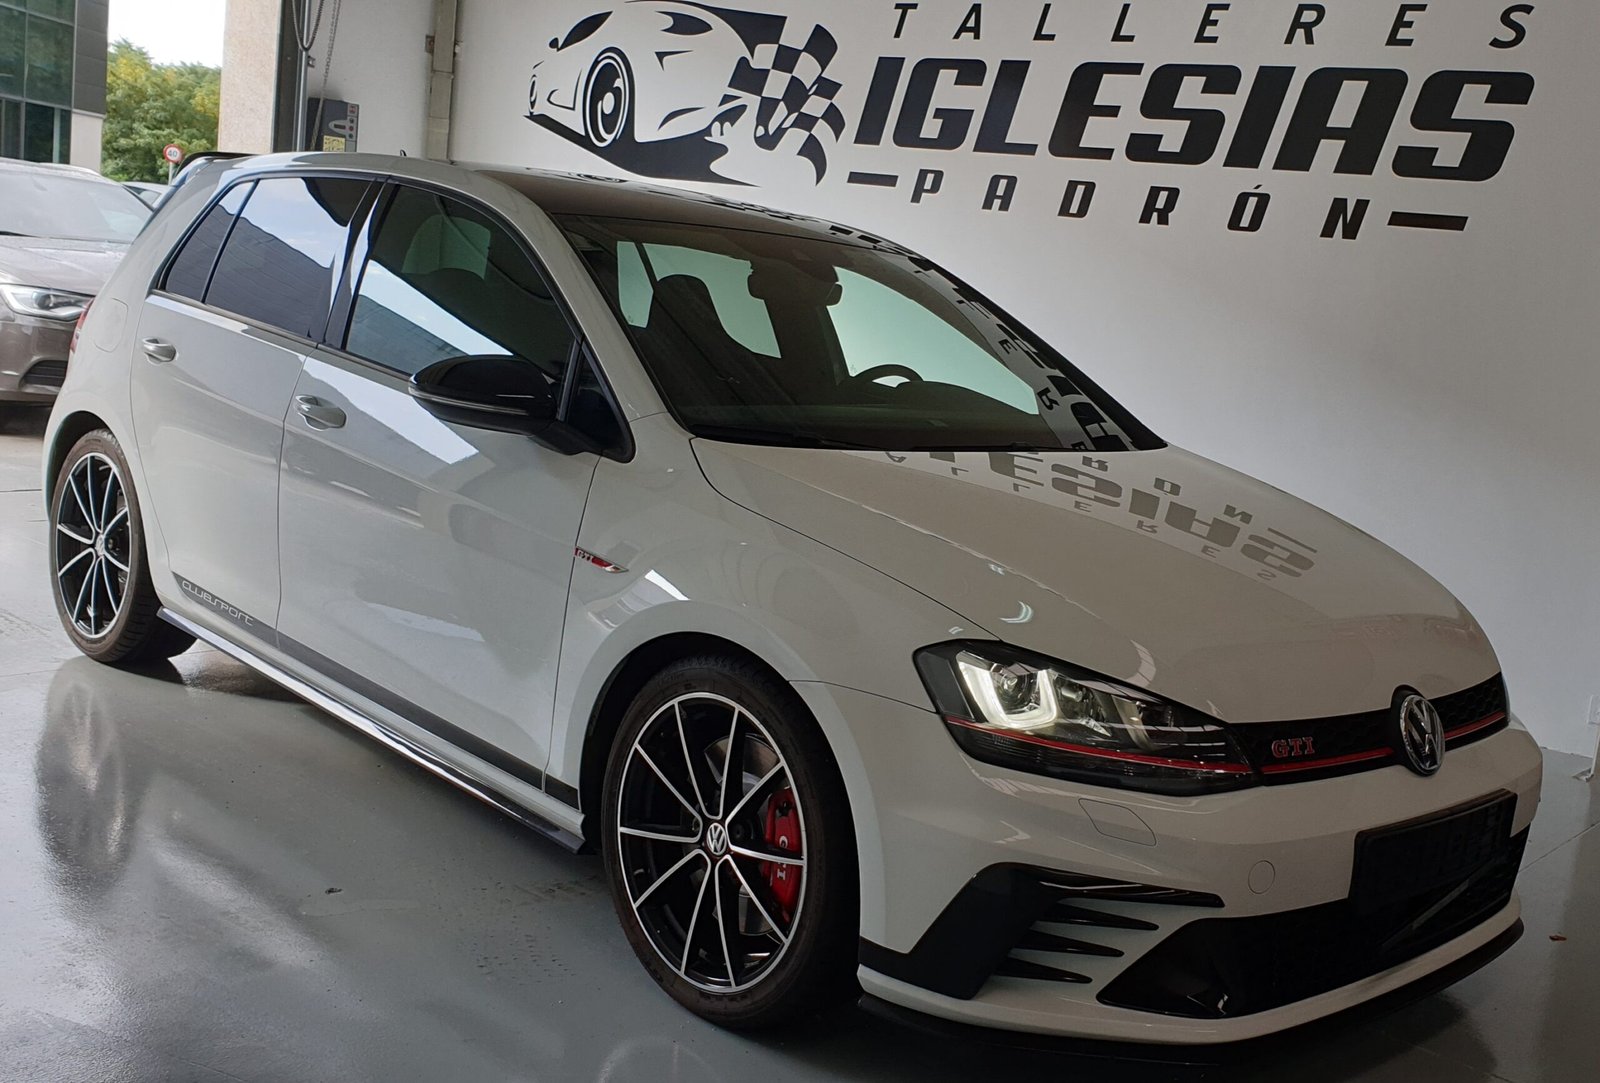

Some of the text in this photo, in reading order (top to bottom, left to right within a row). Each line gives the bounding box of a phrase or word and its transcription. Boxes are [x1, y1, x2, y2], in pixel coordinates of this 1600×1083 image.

[893, 3, 1535, 49] TALLERES
[854, 56, 1535, 182] IGLESIAS
[911, 169, 1371, 241] PADRÓN
[182, 580, 254, 627] CLUBSPORT
[1271, 736, 1315, 759] GTI
[775, 835, 789, 880] GI
